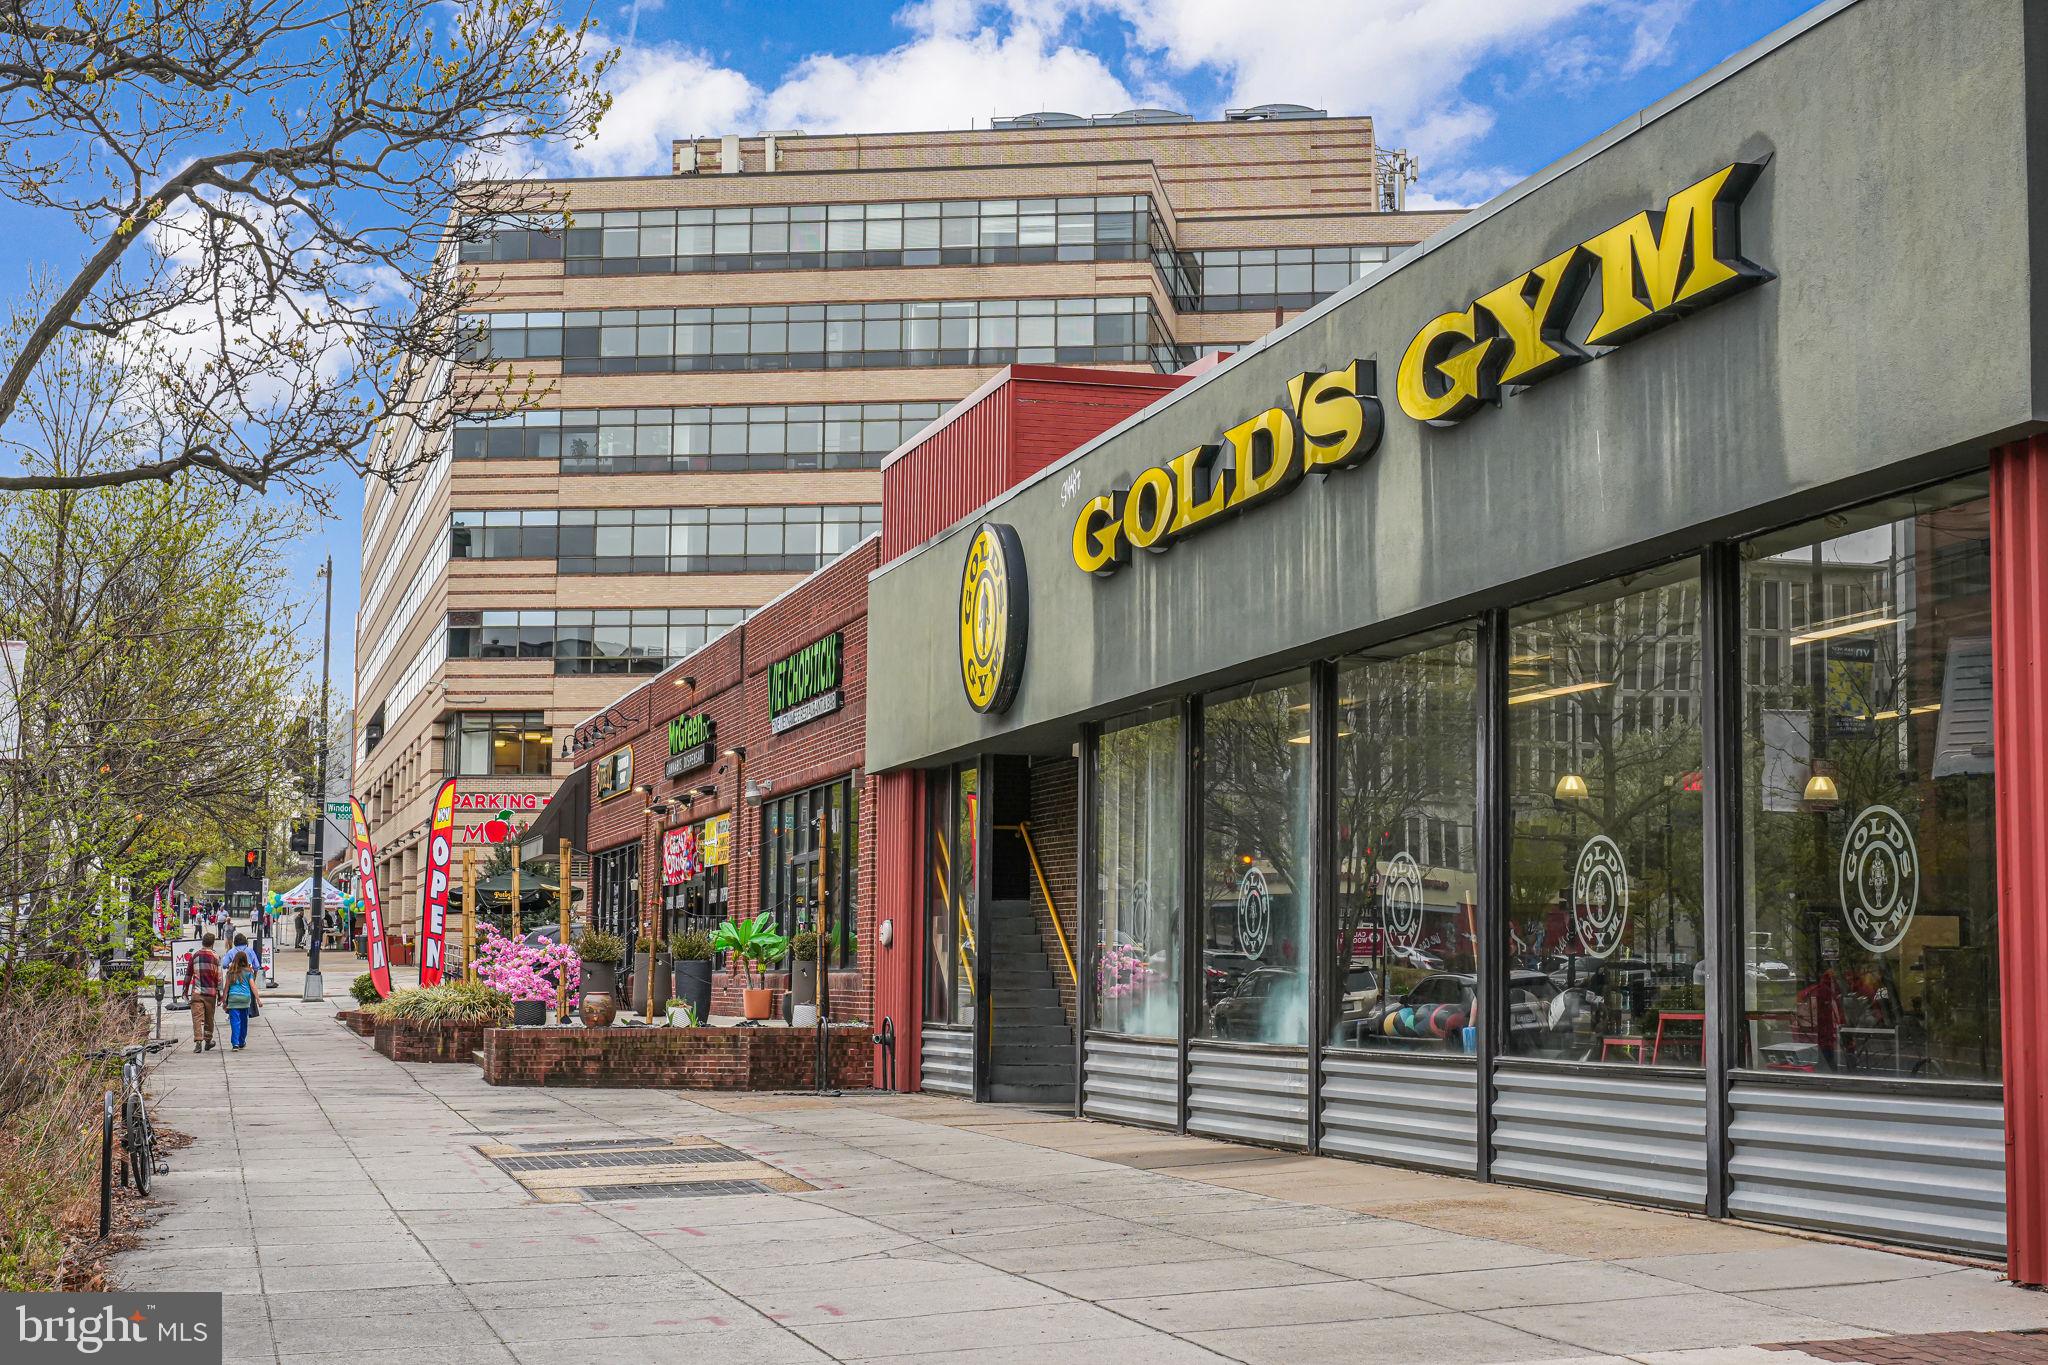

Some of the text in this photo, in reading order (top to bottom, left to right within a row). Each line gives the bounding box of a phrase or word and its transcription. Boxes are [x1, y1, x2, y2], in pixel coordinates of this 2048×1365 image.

[1072, 162, 1738, 574] GOLD'S GYM
[768, 633, 836, 723] VIET CHOPSTICKS
[968, 645, 1001, 697] GYM
[453, 793, 536, 809] PARKING
[426, 835, 450, 969] OPEN
[1854, 896, 1909, 939] GYM
[1582, 916, 1622, 947] GYM
